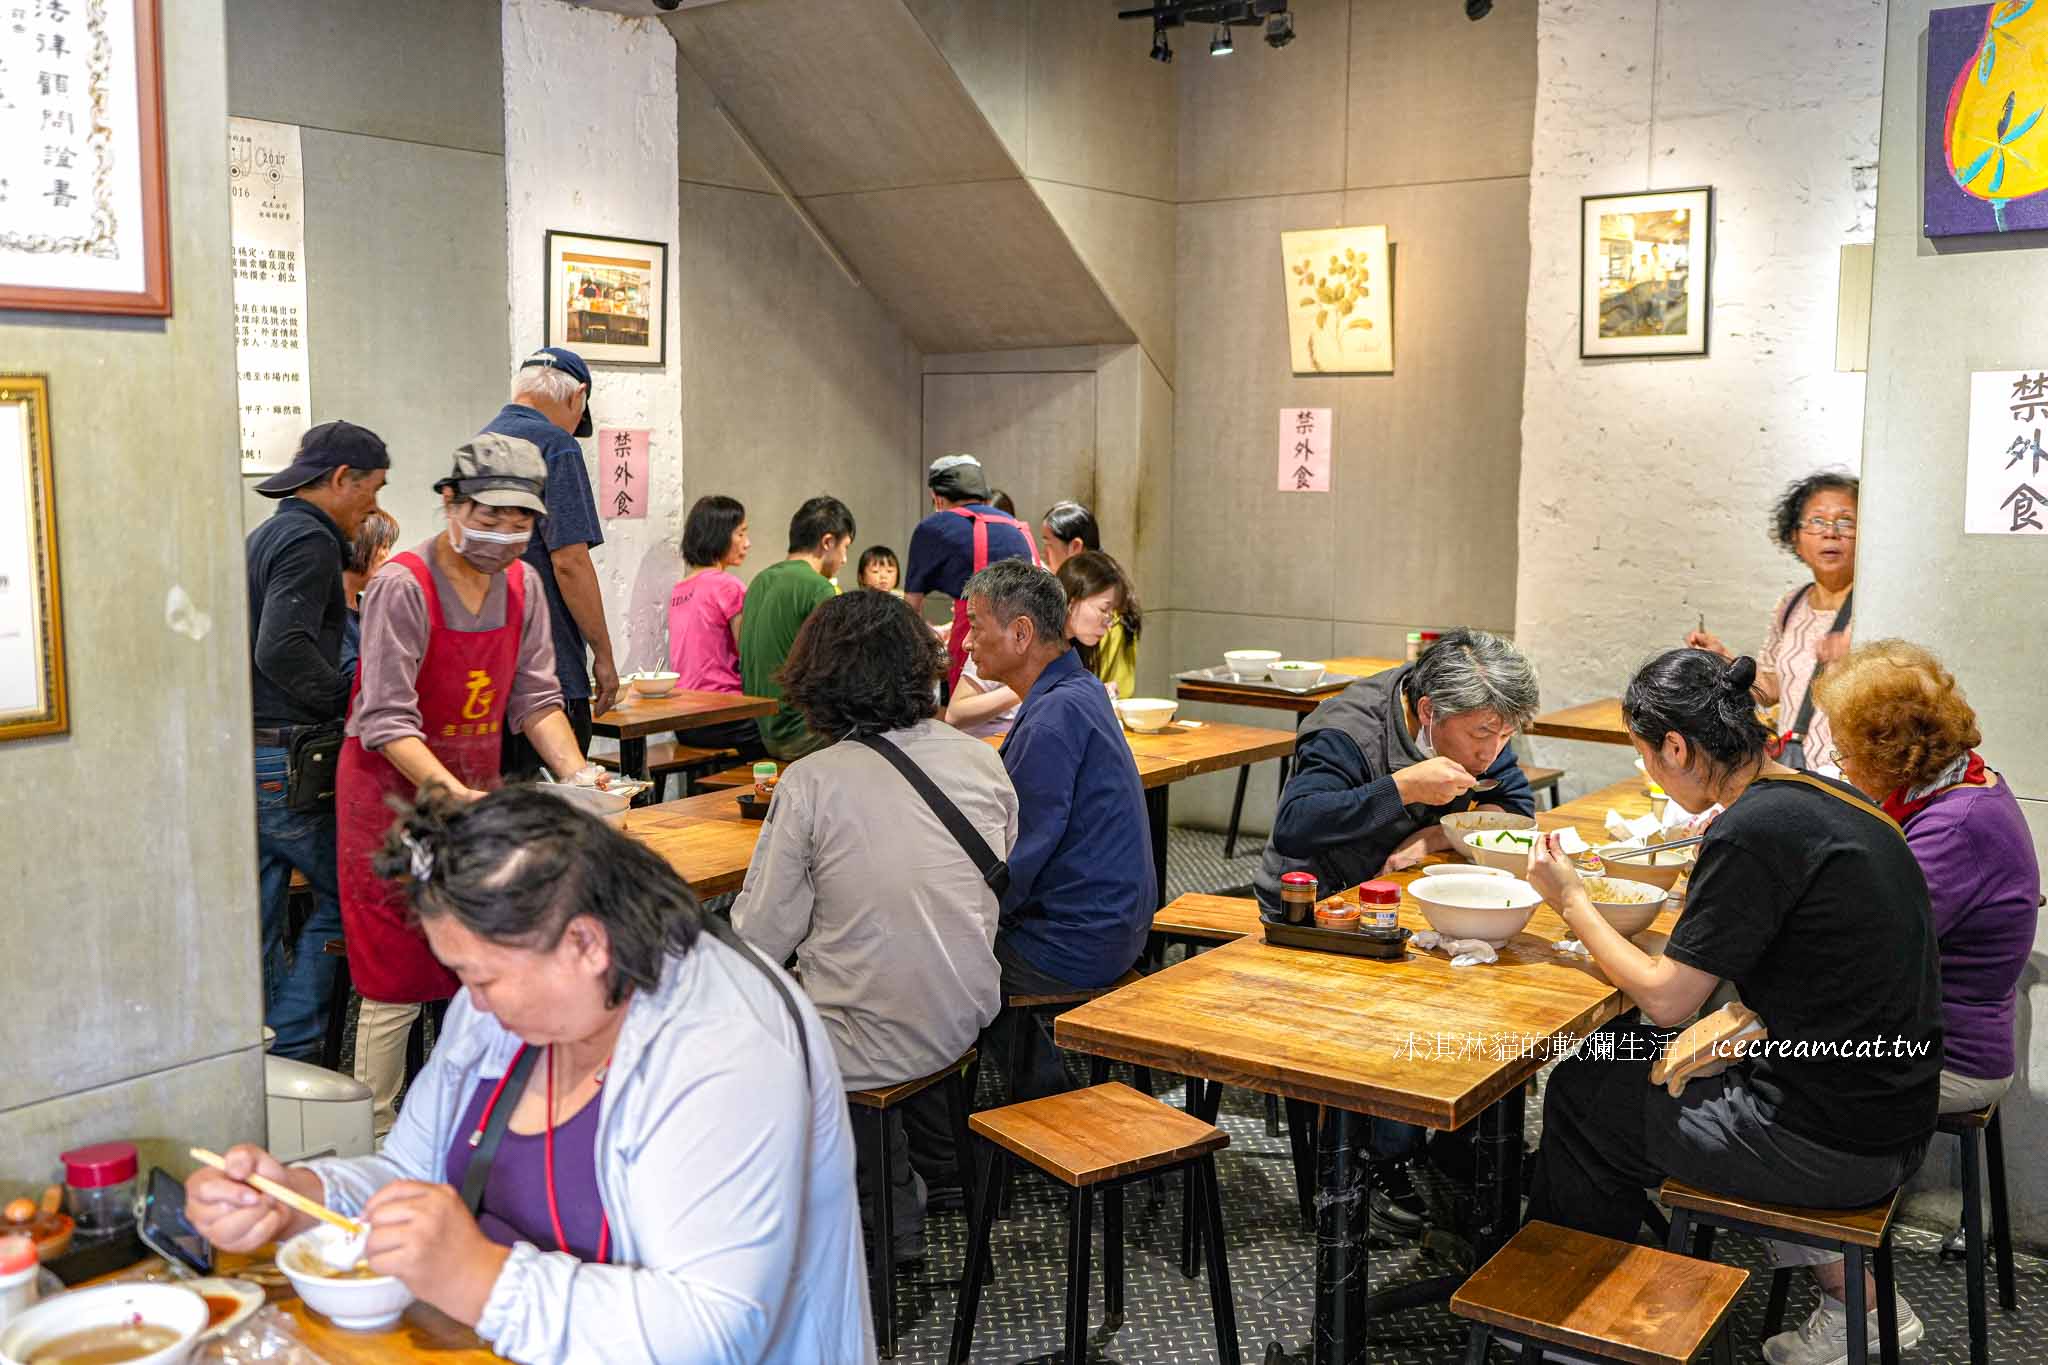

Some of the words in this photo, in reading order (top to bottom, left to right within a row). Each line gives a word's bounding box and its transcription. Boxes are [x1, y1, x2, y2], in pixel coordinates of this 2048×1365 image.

[263, 151, 286, 166] 2017
[613, 431, 634, 515] 禁外食
[1291, 410, 1315, 490] 禁外食
[1999, 372, 2048, 532] 禁外食
